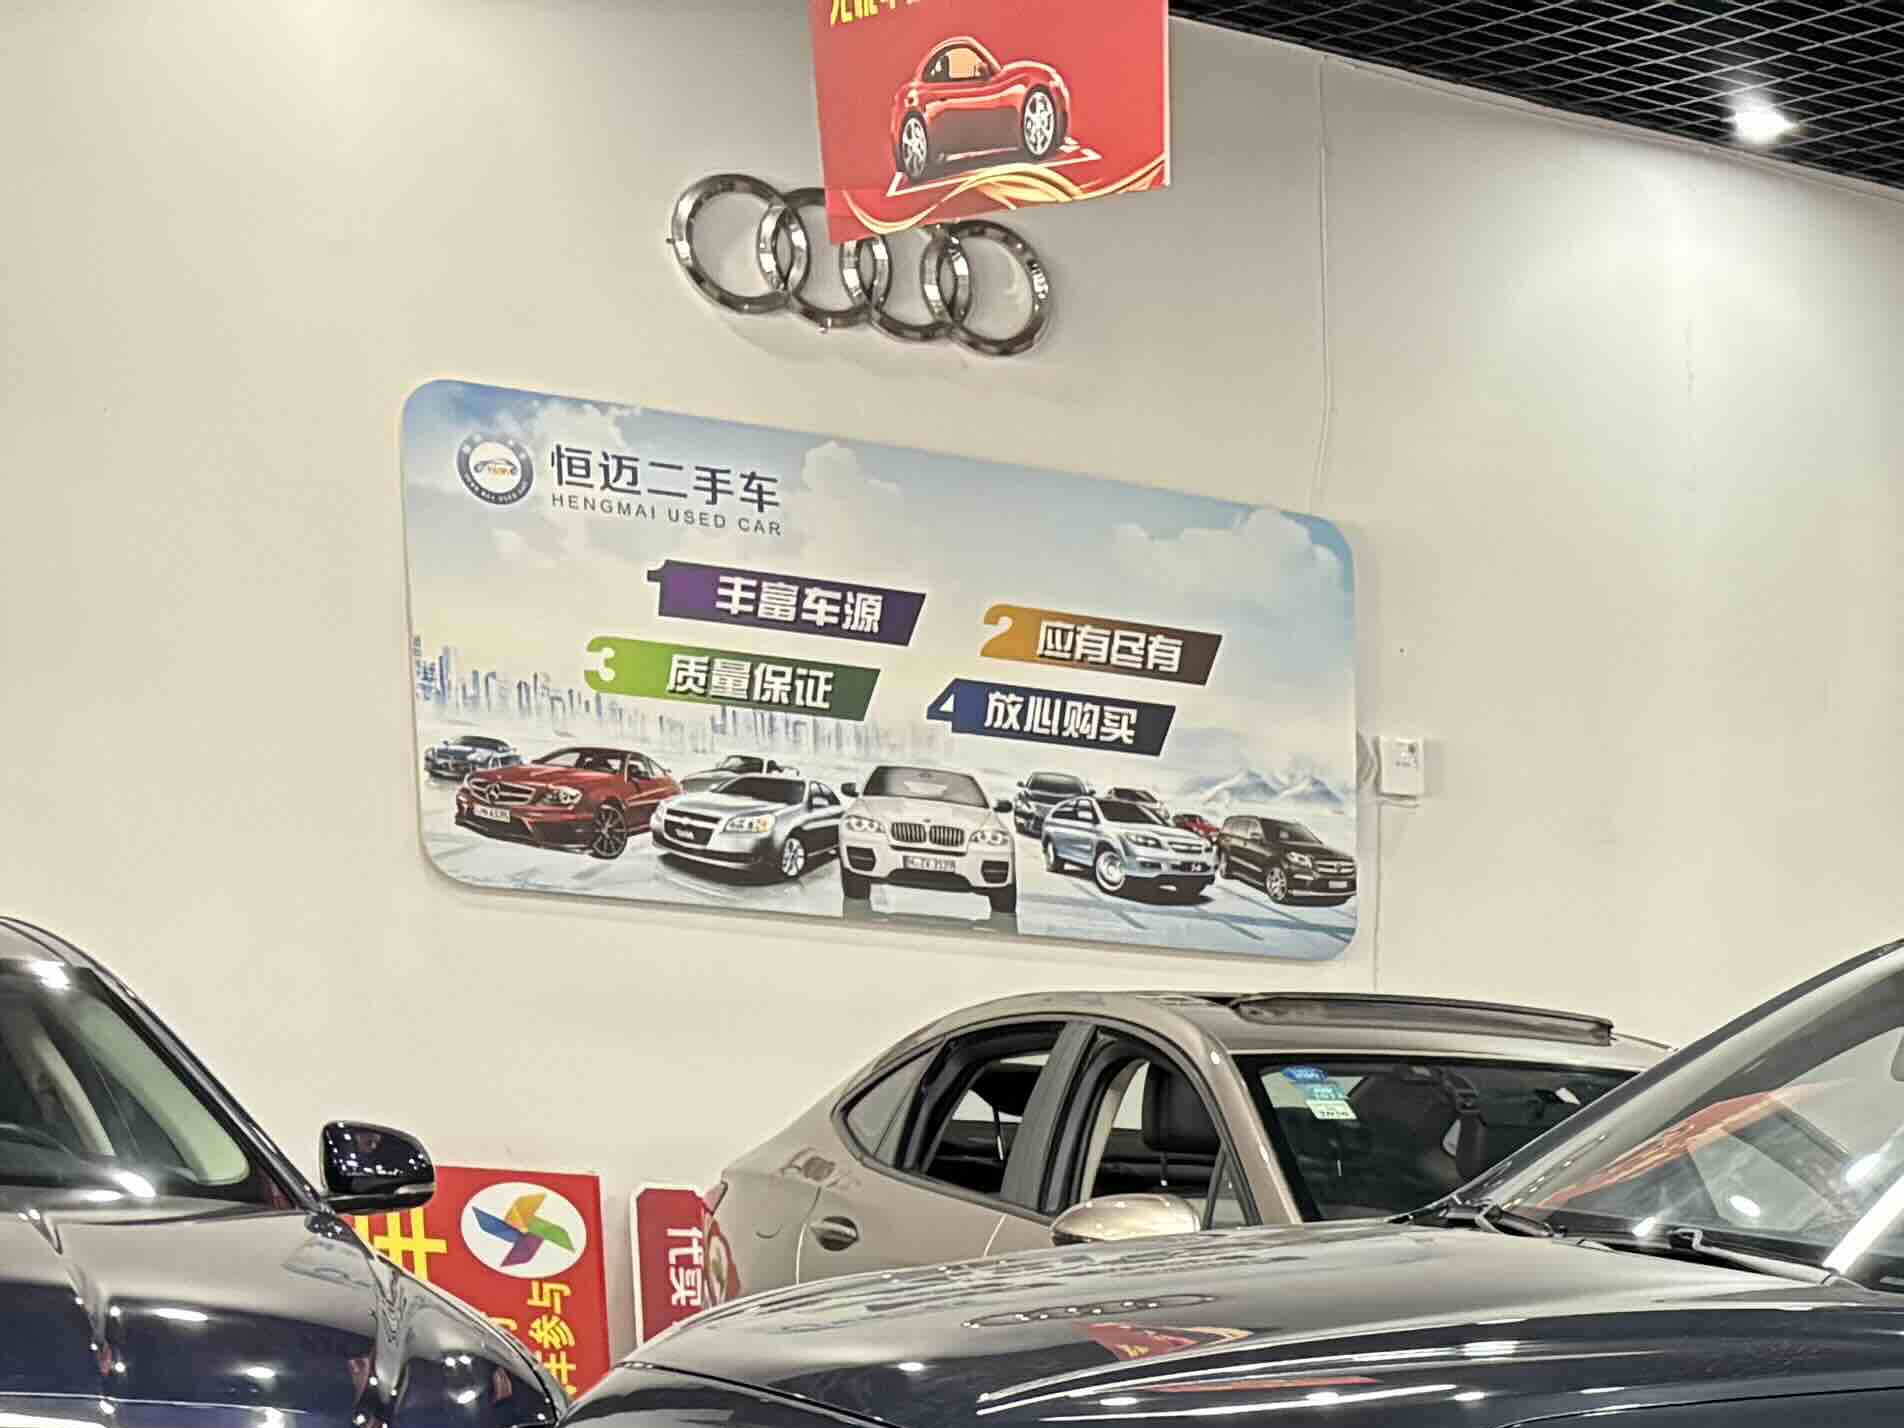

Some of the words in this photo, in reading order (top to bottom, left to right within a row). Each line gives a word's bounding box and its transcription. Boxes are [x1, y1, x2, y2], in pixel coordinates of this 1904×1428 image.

[551, 444, 781, 512] 恒迈二手车
[552, 493, 656, 520] HENGMAI
[668, 509, 727, 529] USED
[738, 518, 783, 536] CAR
[716, 574, 884, 636] 丰富车源
[1038, 620, 1184, 674] 应有尽有
[665, 653, 833, 711] 质量保证
[984, 690, 1138, 746] 放心购买
